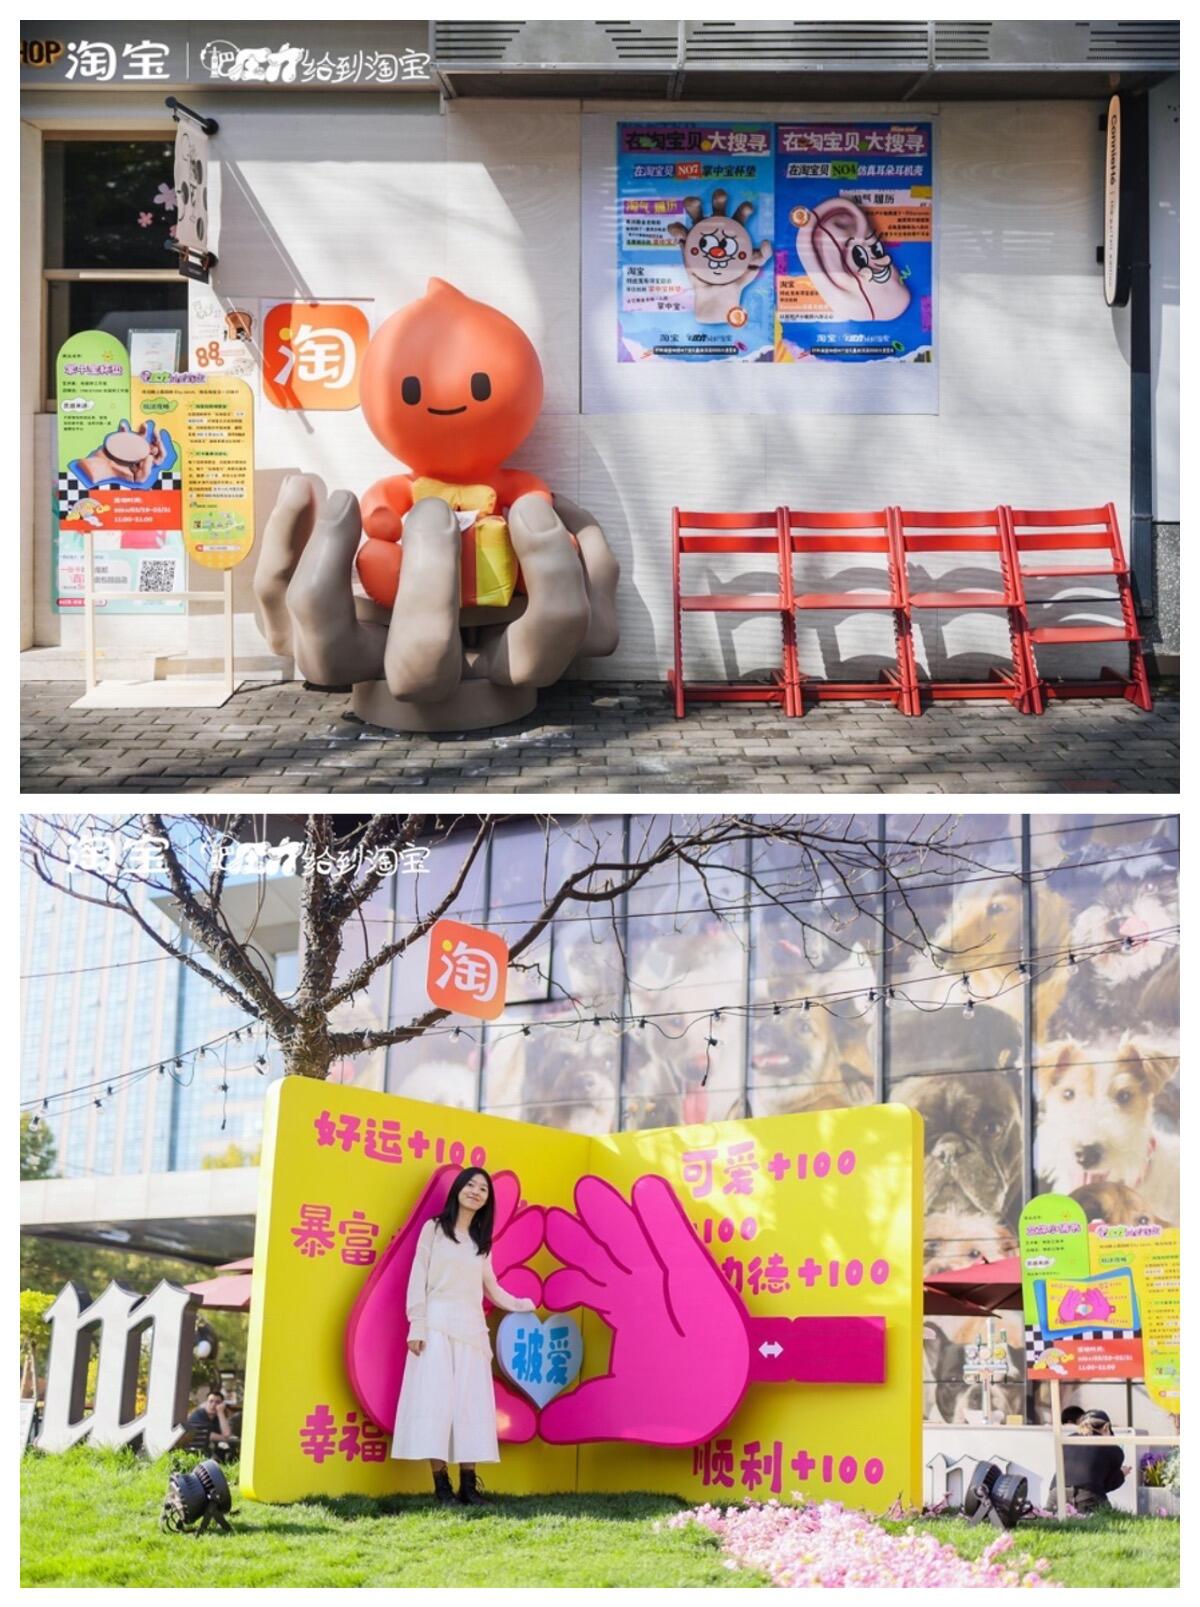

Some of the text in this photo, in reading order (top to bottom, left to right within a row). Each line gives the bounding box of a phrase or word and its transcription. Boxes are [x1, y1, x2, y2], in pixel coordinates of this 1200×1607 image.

[273, 324, 356, 389] 淘
[435, 940, 499, 1002] 淘
[314, 1110, 488, 1166] 好运+100
[681, 1141, 856, 1198] 可爱+100
[692, 1217, 757, 1244] 100
[511, 1326, 573, 1386] 被爱
[299, 1404, 387, 1464] 幸福
